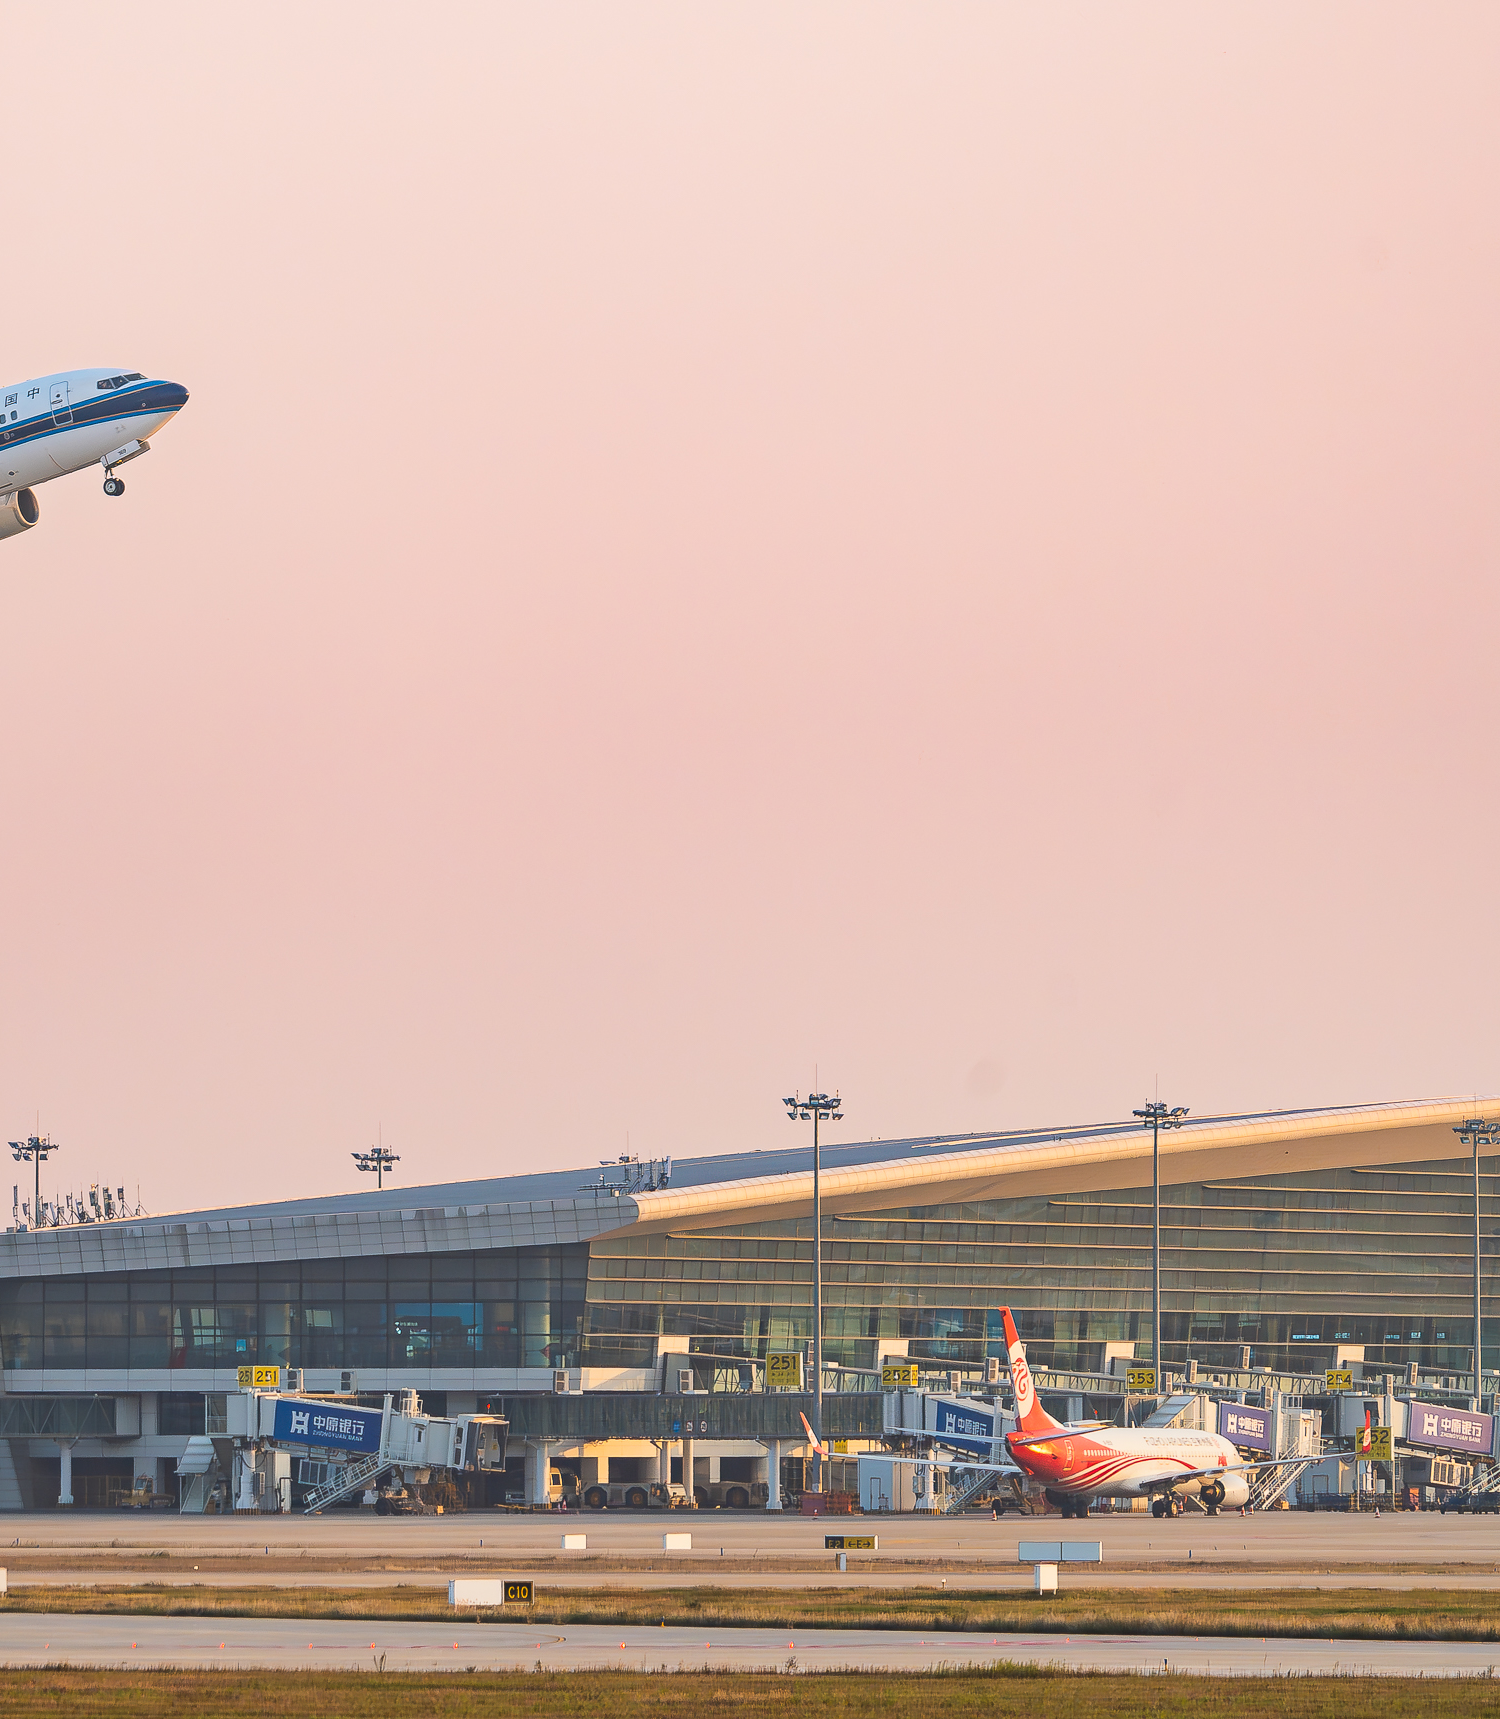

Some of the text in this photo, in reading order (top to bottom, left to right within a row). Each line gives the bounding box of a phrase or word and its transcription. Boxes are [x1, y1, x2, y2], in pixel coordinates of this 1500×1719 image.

[769, 1355, 796, 1371] 251
[256, 1370, 277, 1383] 251
[882, 1369, 911, 1382] 252
[1127, 1372, 1155, 1385] 253
[1326, 1374, 1352, 1386] 254
[313, 1415, 366, 1437] 中原银行
[1238, 1416, 1265, 1433] 中原银行
[1441, 1417, 1483, 1437] 中原银行
[507, 1586, 529, 1599] C10
